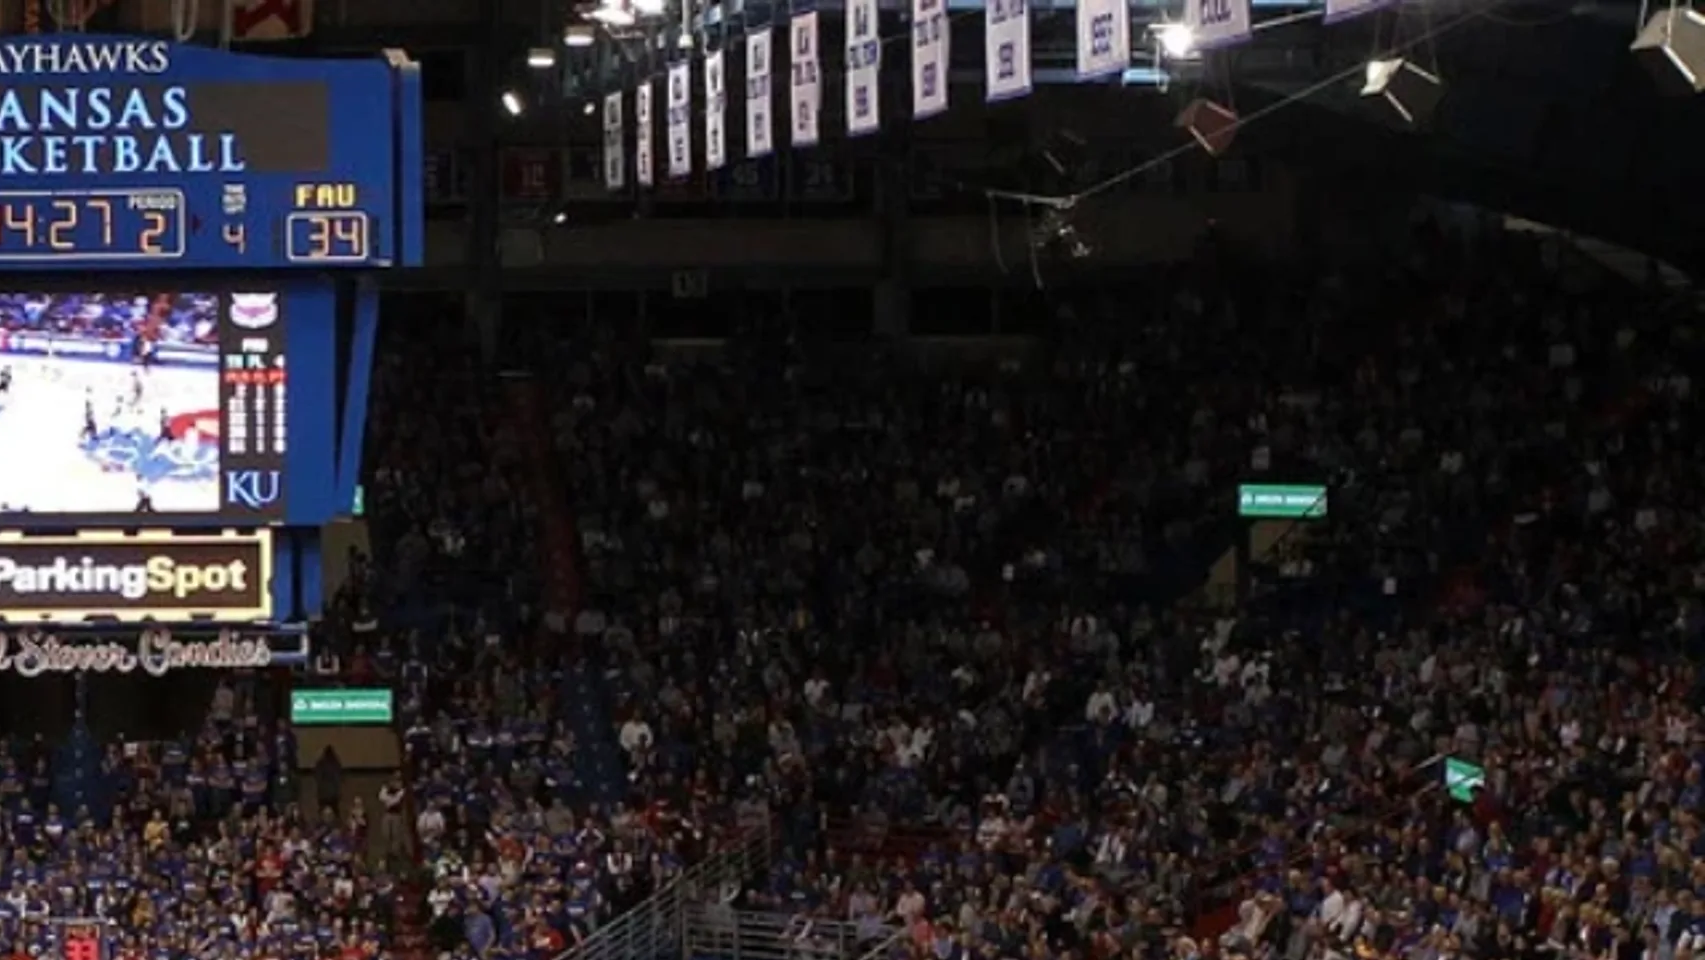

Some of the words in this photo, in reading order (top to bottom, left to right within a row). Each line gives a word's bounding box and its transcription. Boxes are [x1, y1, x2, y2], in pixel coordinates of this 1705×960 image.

[296, 183, 355, 207] FAU
[140, 212, 165, 254] 2
[223, 223, 245, 254] 4
[307, 217, 360, 258] 34
[226, 471, 280, 508] KU
[14, 630, 136, 677] Stover
[140, 629, 272, 677] Candies
